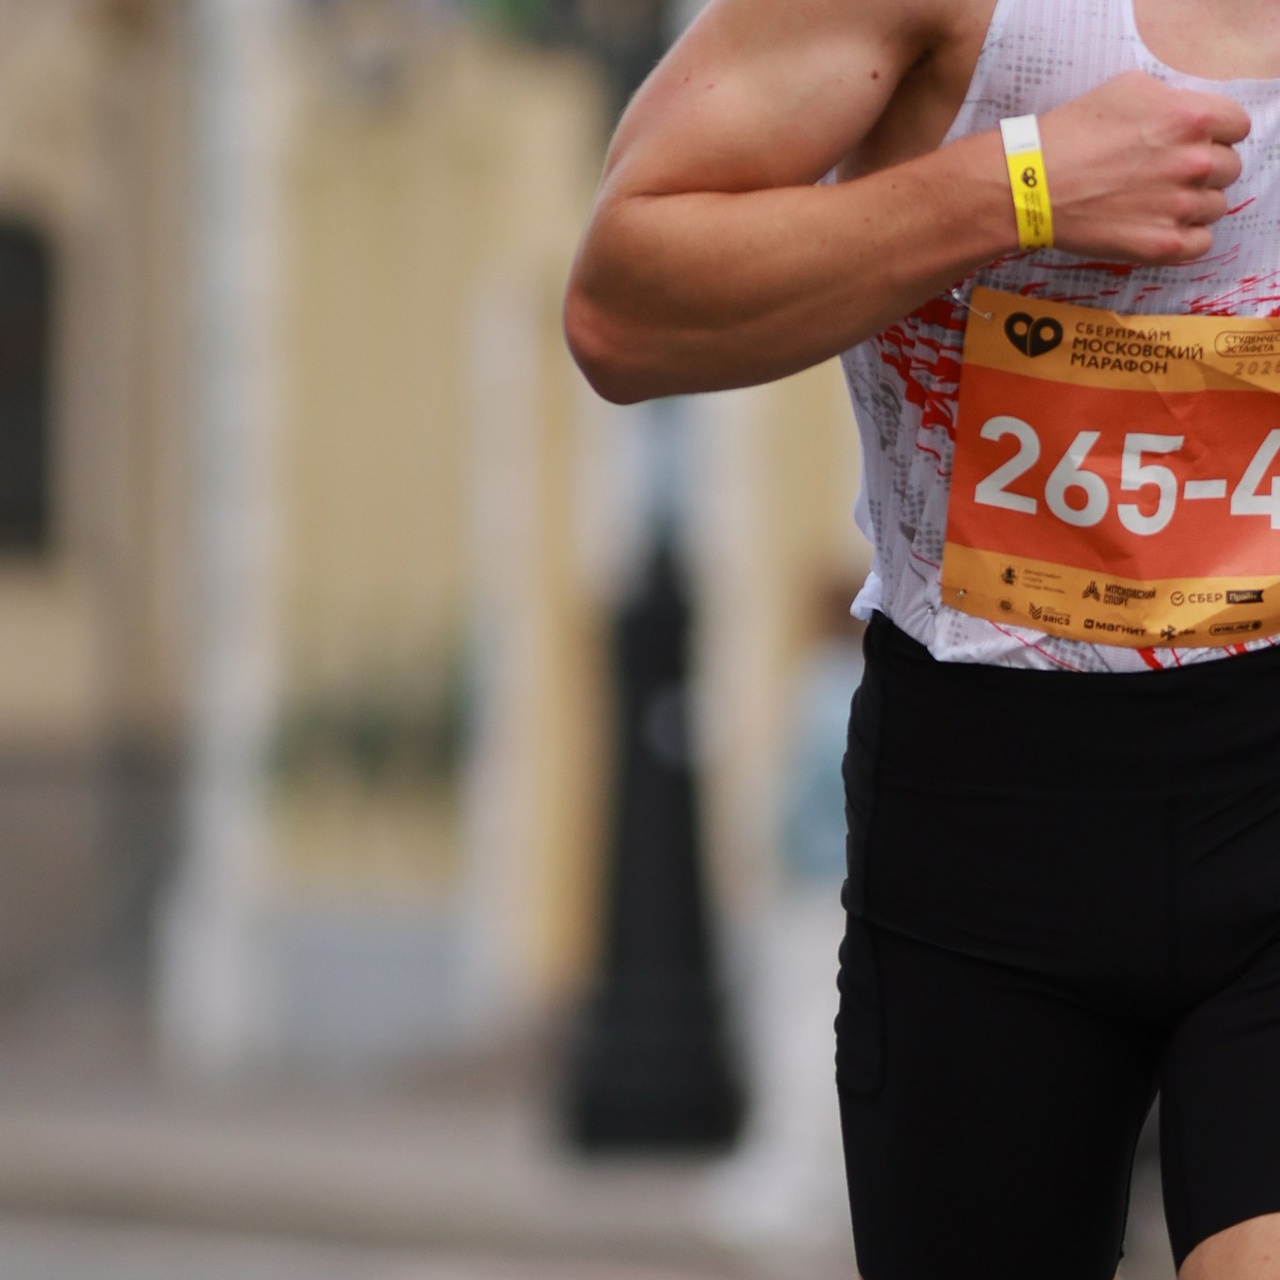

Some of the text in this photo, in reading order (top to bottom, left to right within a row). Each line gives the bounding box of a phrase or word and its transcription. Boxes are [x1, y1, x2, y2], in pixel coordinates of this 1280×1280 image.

[1075, 321, 1171, 341] СБЕРПРАЙМ
[1072, 337, 1204, 361] МОСКОВСКИЙ
[1070, 351, 1169, 375] МАРАФОН
[1102, 593, 1129, 608] СПОРТ
[1187, 591, 1223, 604] СБЕР
